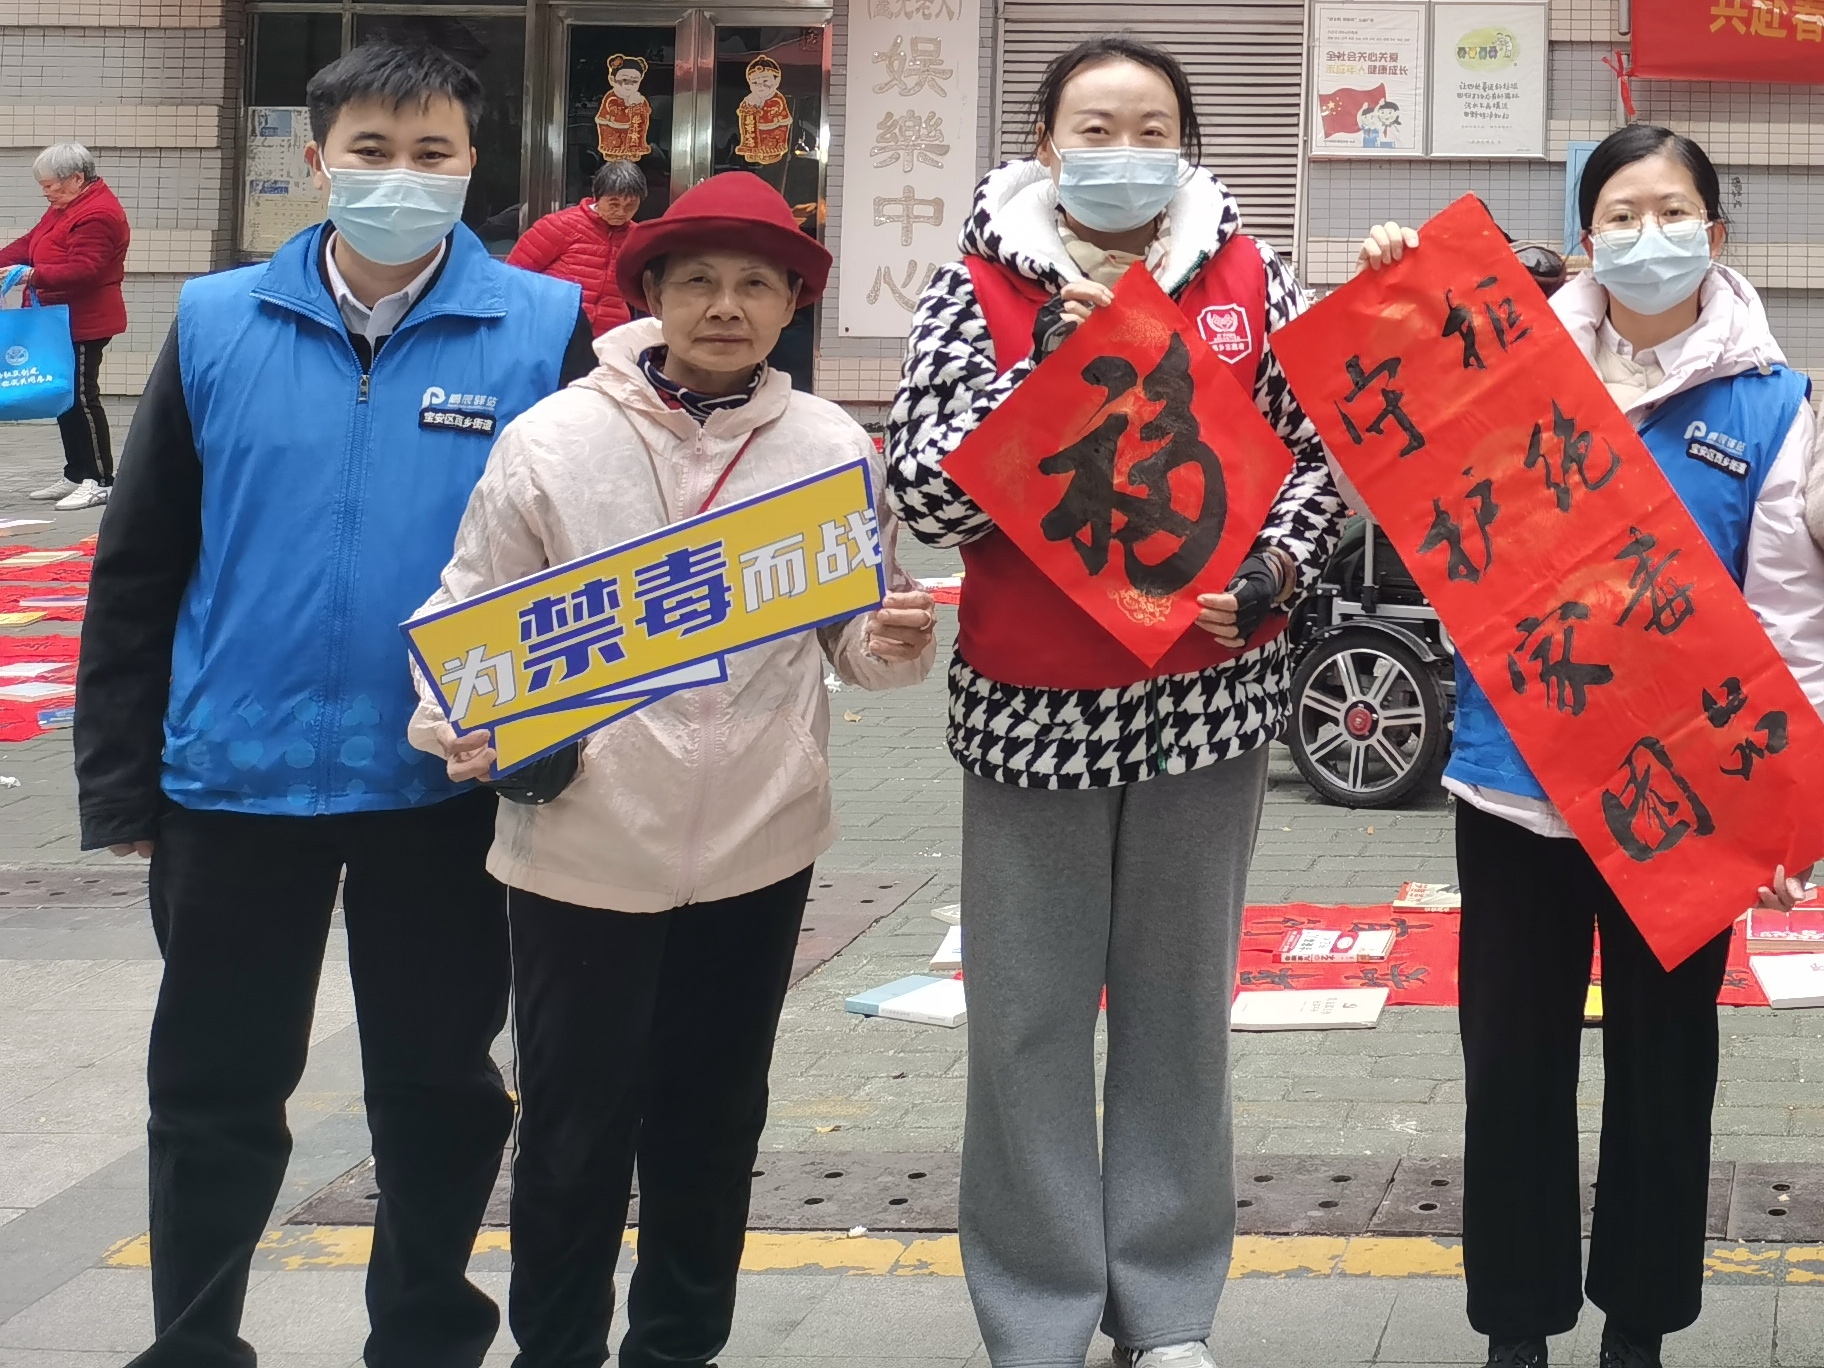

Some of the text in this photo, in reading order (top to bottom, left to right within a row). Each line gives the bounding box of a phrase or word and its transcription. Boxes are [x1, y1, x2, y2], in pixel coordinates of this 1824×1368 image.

[1325, 50, 1399, 63] 全社会关心关爱
[1325, 64, 1409, 76] 未成年人健康成长
[1038, 330, 1229, 598] 福
[440, 508, 883, 722] 为禁毒而战
